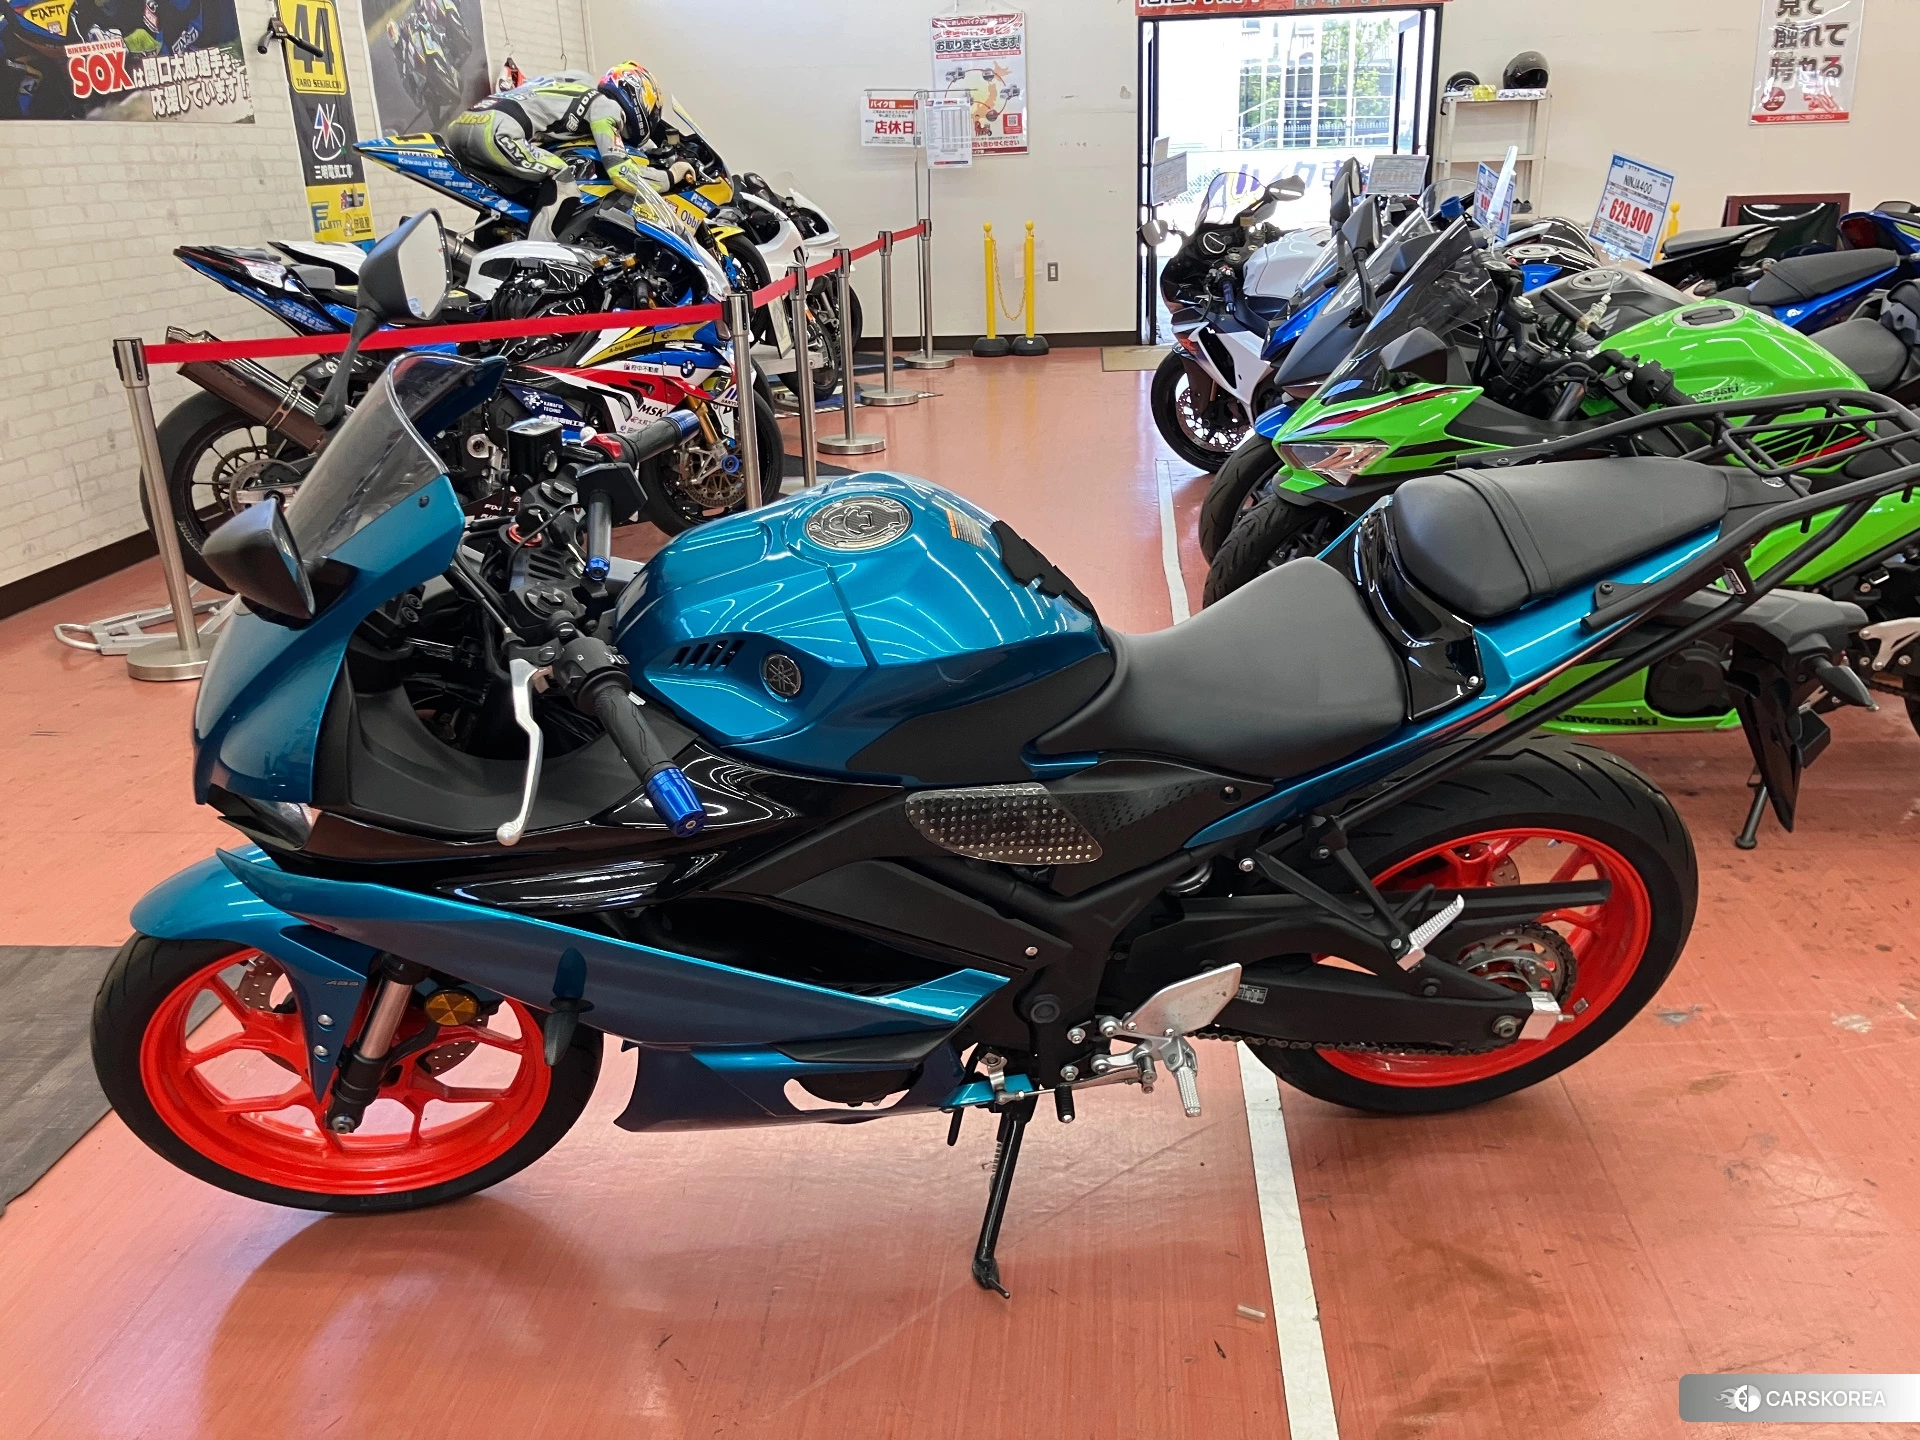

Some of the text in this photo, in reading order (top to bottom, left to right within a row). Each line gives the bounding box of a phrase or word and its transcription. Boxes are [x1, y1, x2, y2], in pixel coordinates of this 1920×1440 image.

[30, 4, 65, 20] FIXFIT
[293, 4, 334, 76] 44
[67, 41, 121, 55] BIKERS STATION
[69, 50, 134, 98] SOX
[296, 78, 311, 87] TARO
[875, 120, 914, 135] 店休日
[1609, 198, 1653, 234] 629,900
[638, 404, 667, 418] MSK
